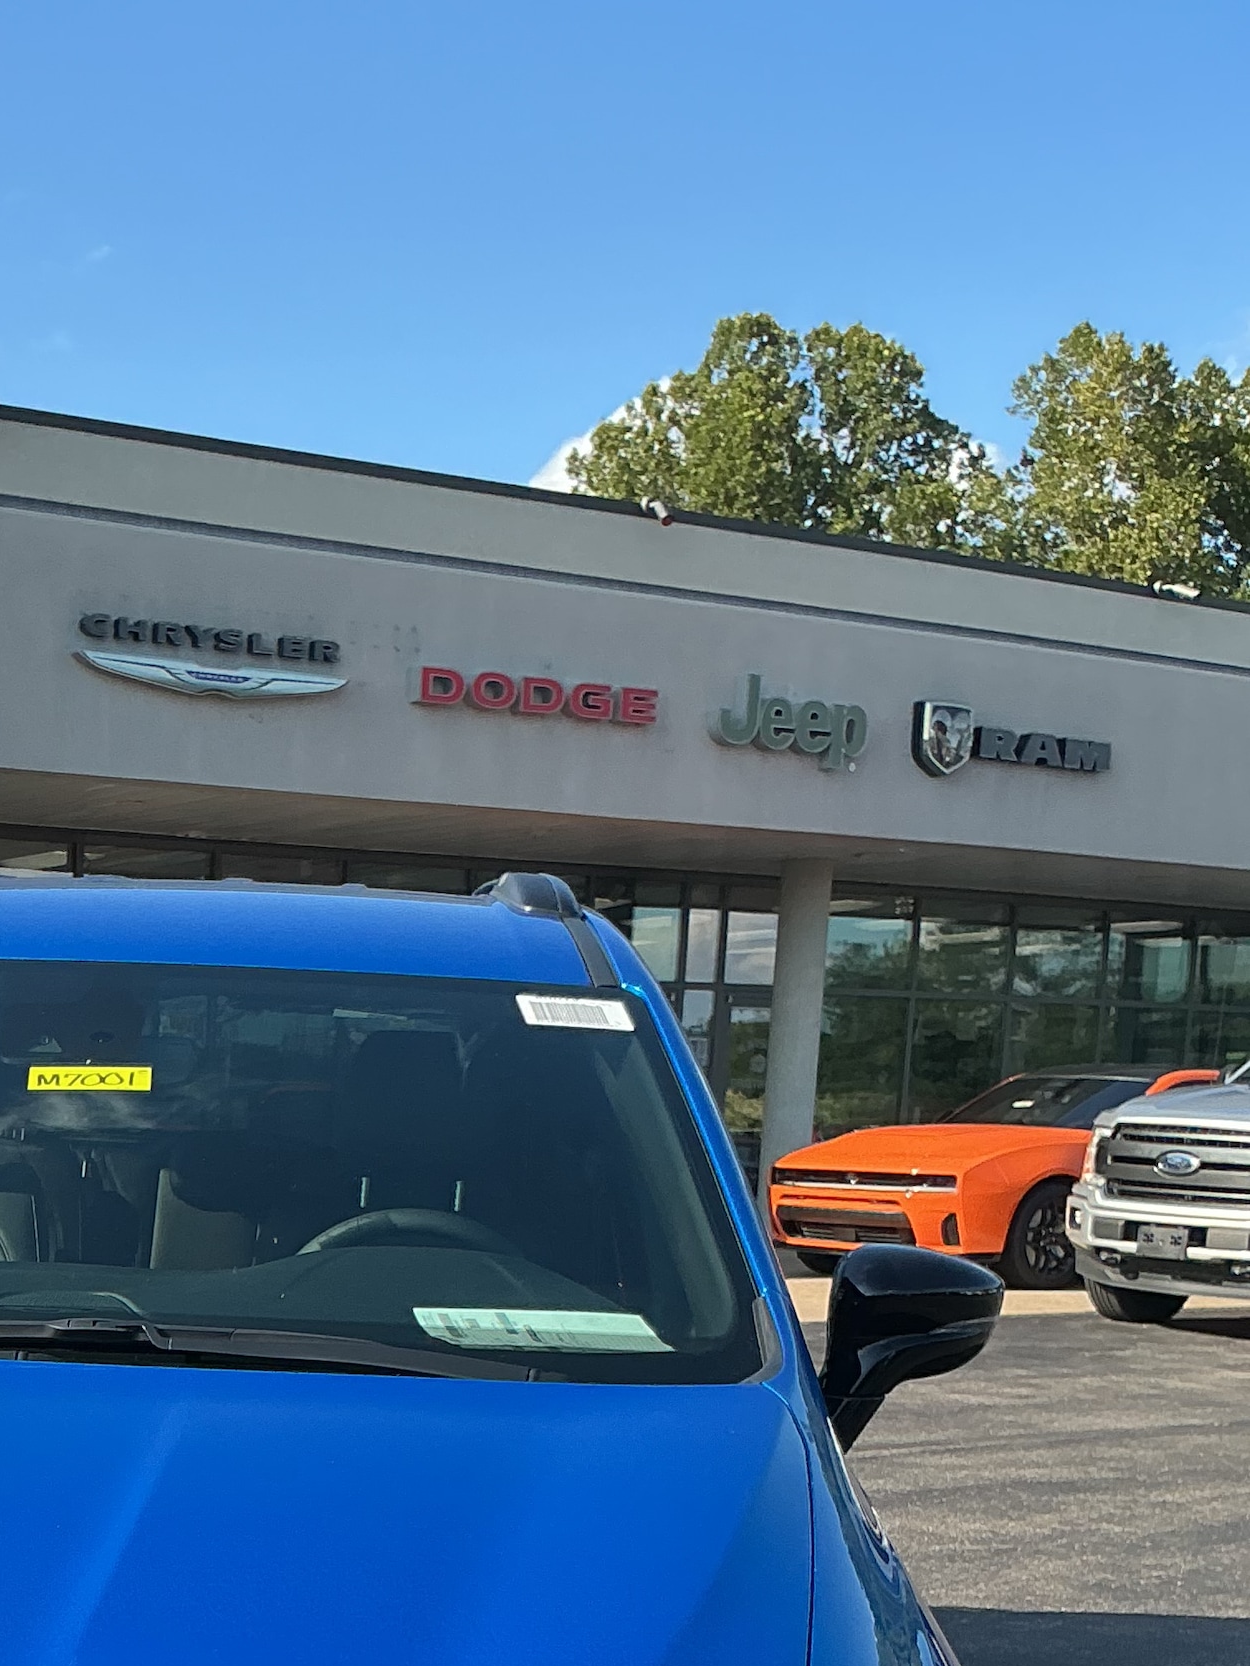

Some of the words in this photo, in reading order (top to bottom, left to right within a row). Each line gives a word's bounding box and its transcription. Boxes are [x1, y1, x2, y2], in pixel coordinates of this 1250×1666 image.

[78, 612, 341, 664] CHRYSLER
[420, 666, 659, 724] DODGE
[710, 673, 868, 770] Jeep
[974, 726, 1113, 772] RAM
